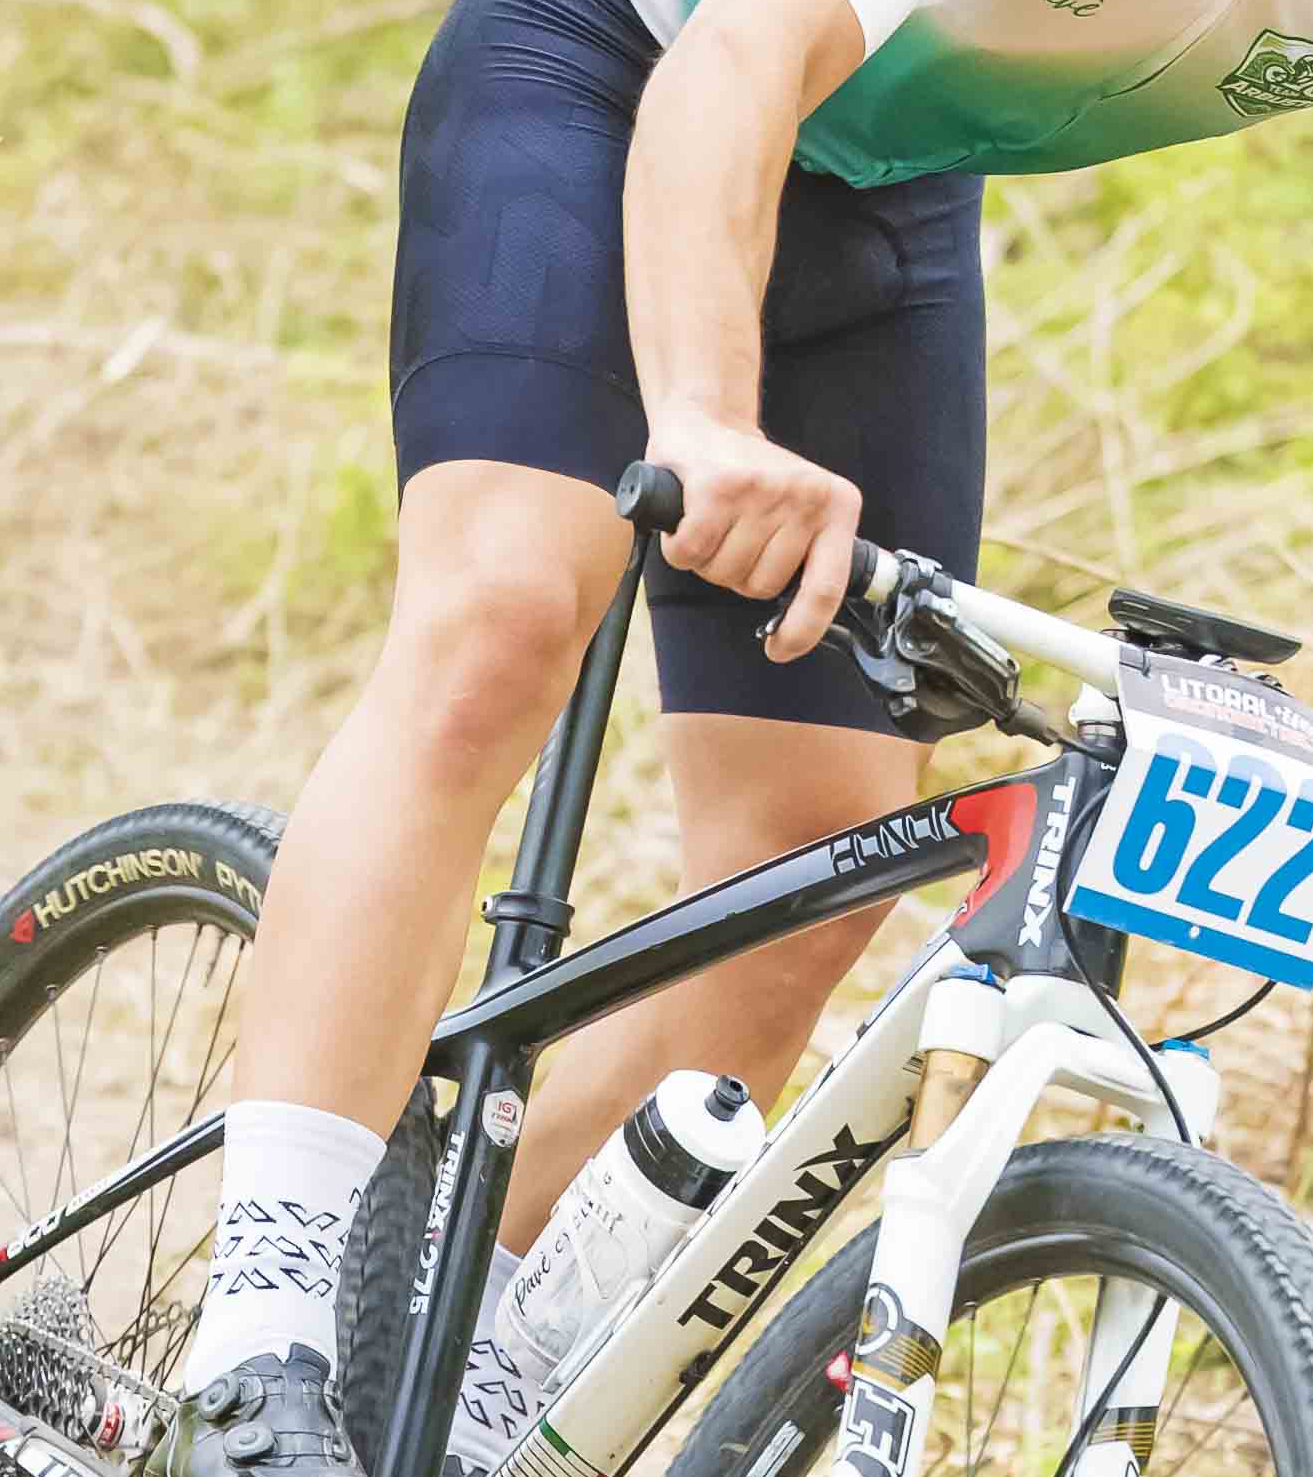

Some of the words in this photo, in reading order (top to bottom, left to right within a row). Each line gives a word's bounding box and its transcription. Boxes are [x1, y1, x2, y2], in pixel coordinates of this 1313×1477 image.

[32, 848, 202, 928] HUTCHINSON
[214, 859, 264, 918] PYT
[1017, 776, 1078, 948] TRINX
[425, 1129, 466, 1239] TRINX
[676, 1123, 881, 1330] TRINX
